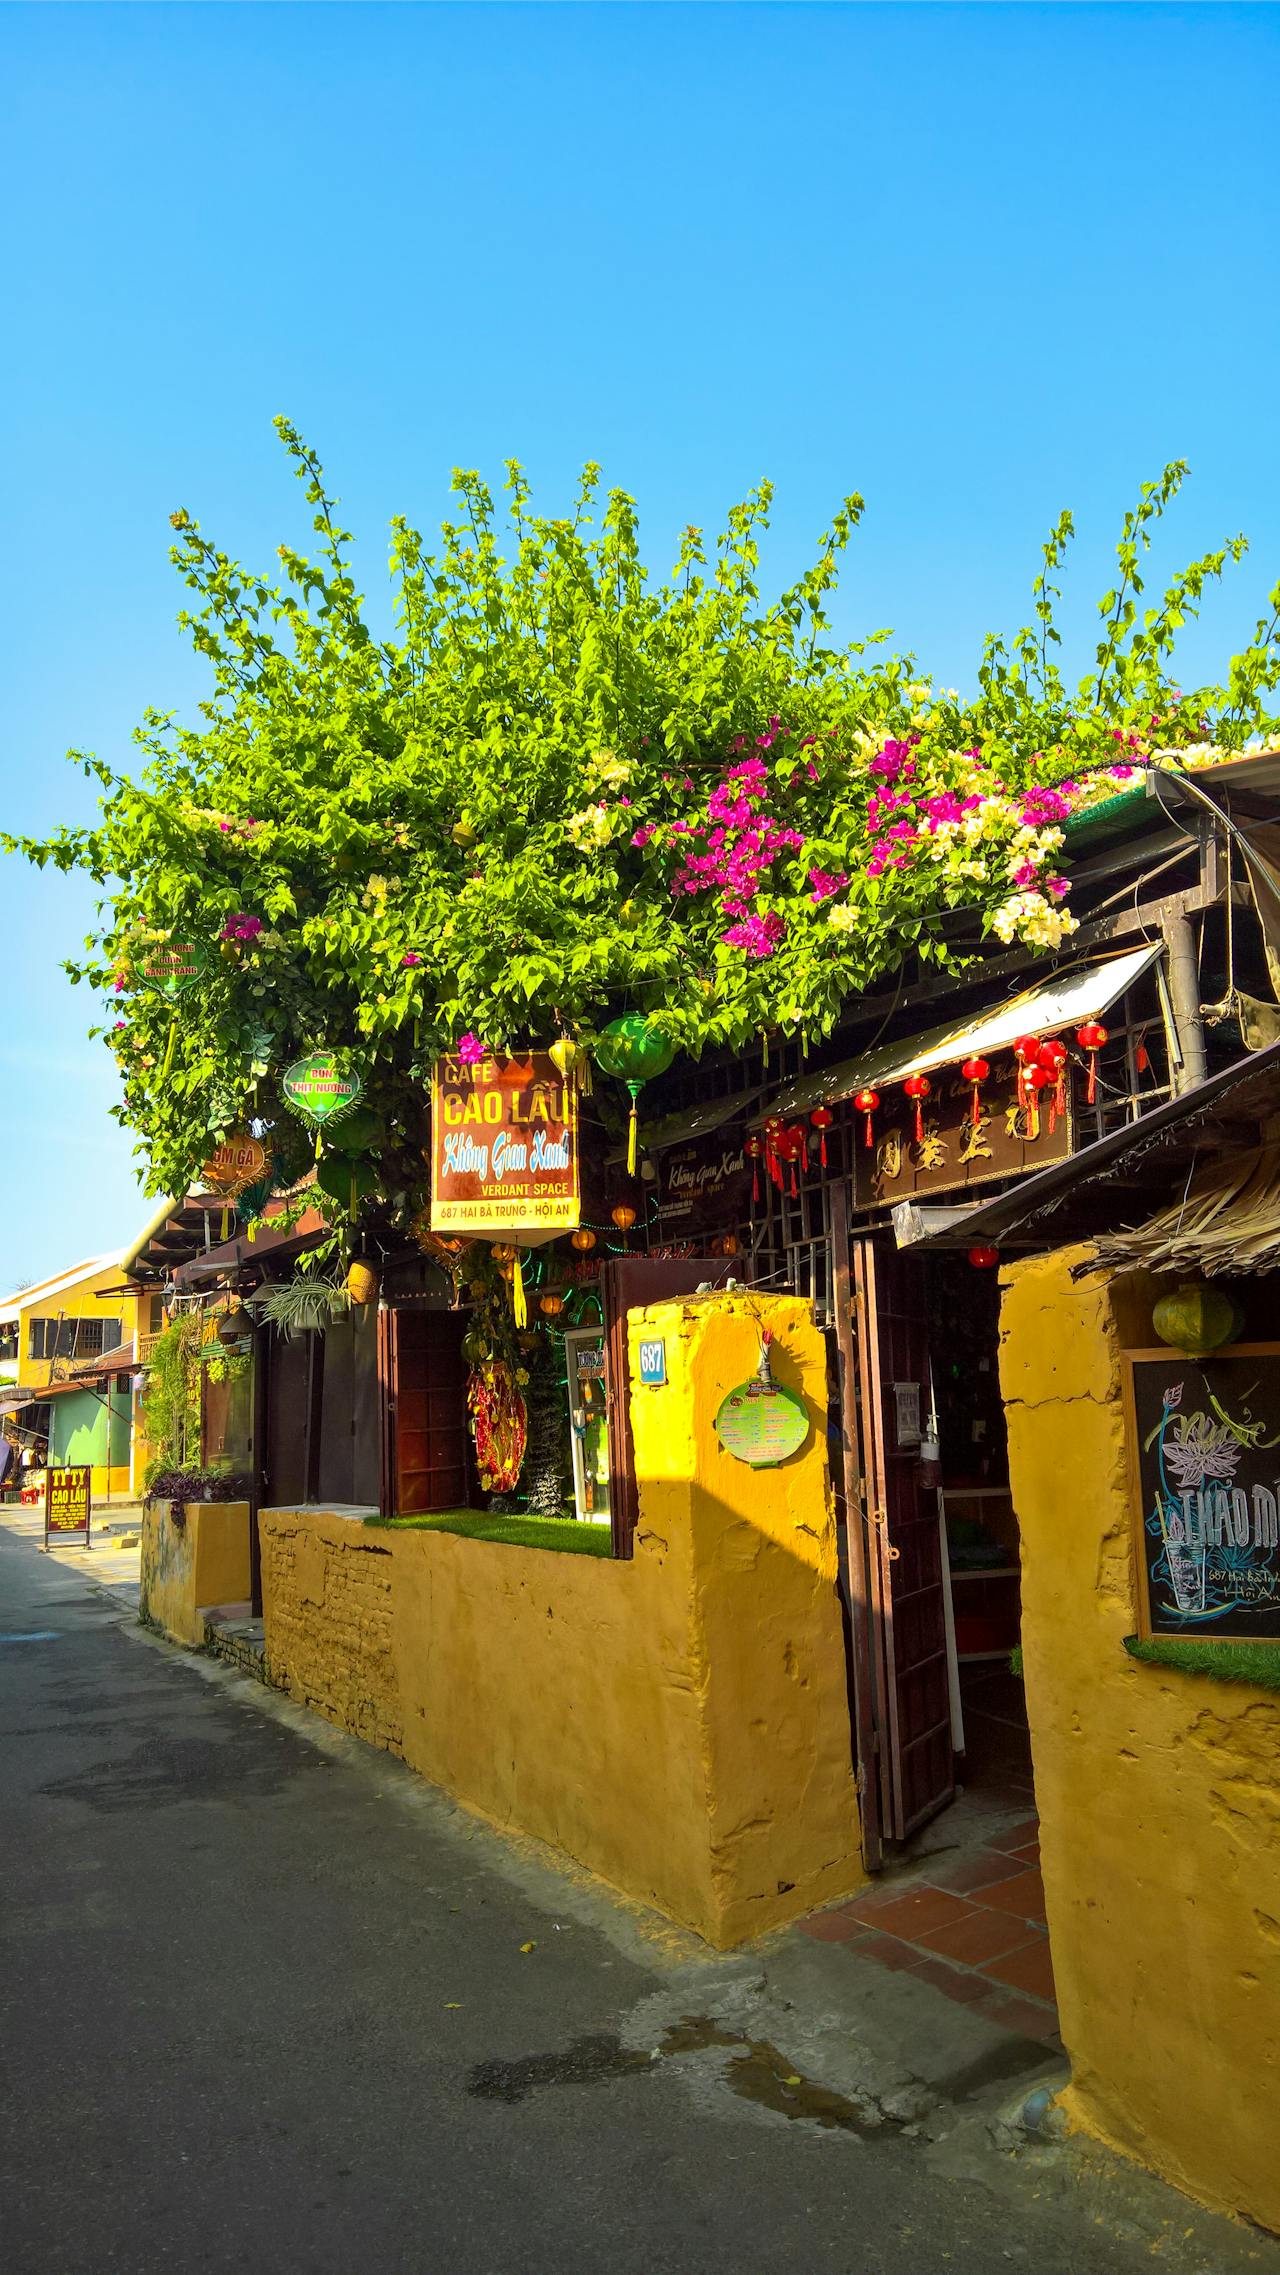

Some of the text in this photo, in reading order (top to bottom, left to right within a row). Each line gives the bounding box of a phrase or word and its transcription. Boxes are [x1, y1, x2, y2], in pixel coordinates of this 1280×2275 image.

[444, 1091, 503, 1125] CAO
[441, 1128, 569, 1181] Không Gian Xanh
[482, 1182, 569, 1196] VERDANT SPACE
[440, 1207, 457, 1219] 687
[460, 1207, 477, 1218] HAI
[555, 1205, 569, 1216] AN
[640, 1344, 662, 1373] 687
[51, 1489, 69, 1505] CAO
[1251, 1481, 1280, 1548] M
[1209, 1571, 1226, 1581] 687
